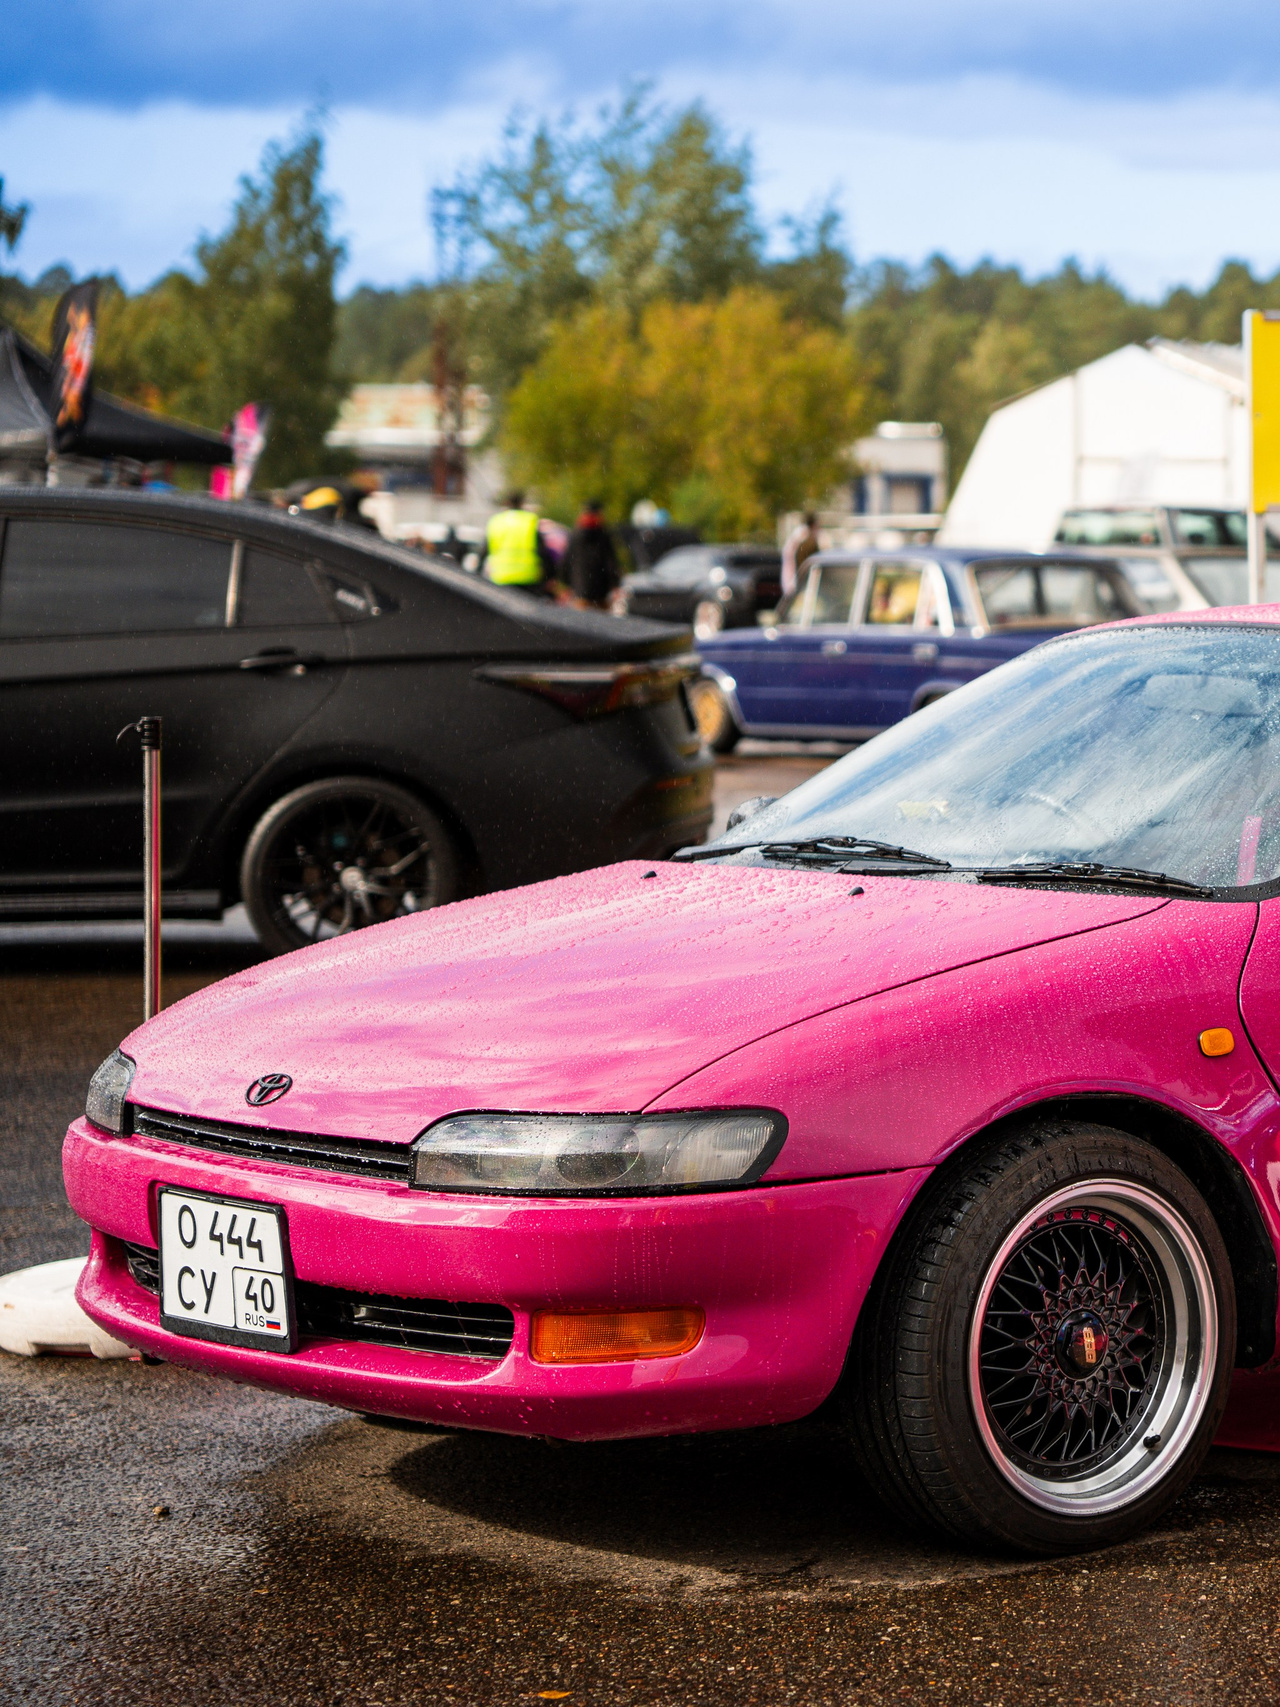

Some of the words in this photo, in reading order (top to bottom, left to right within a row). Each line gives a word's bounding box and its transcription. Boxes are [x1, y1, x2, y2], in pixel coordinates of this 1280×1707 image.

[209, 1210, 264, 1263] 444
[244, 1275, 275, 1314] 40
[244, 1312, 266, 1327] RUS
